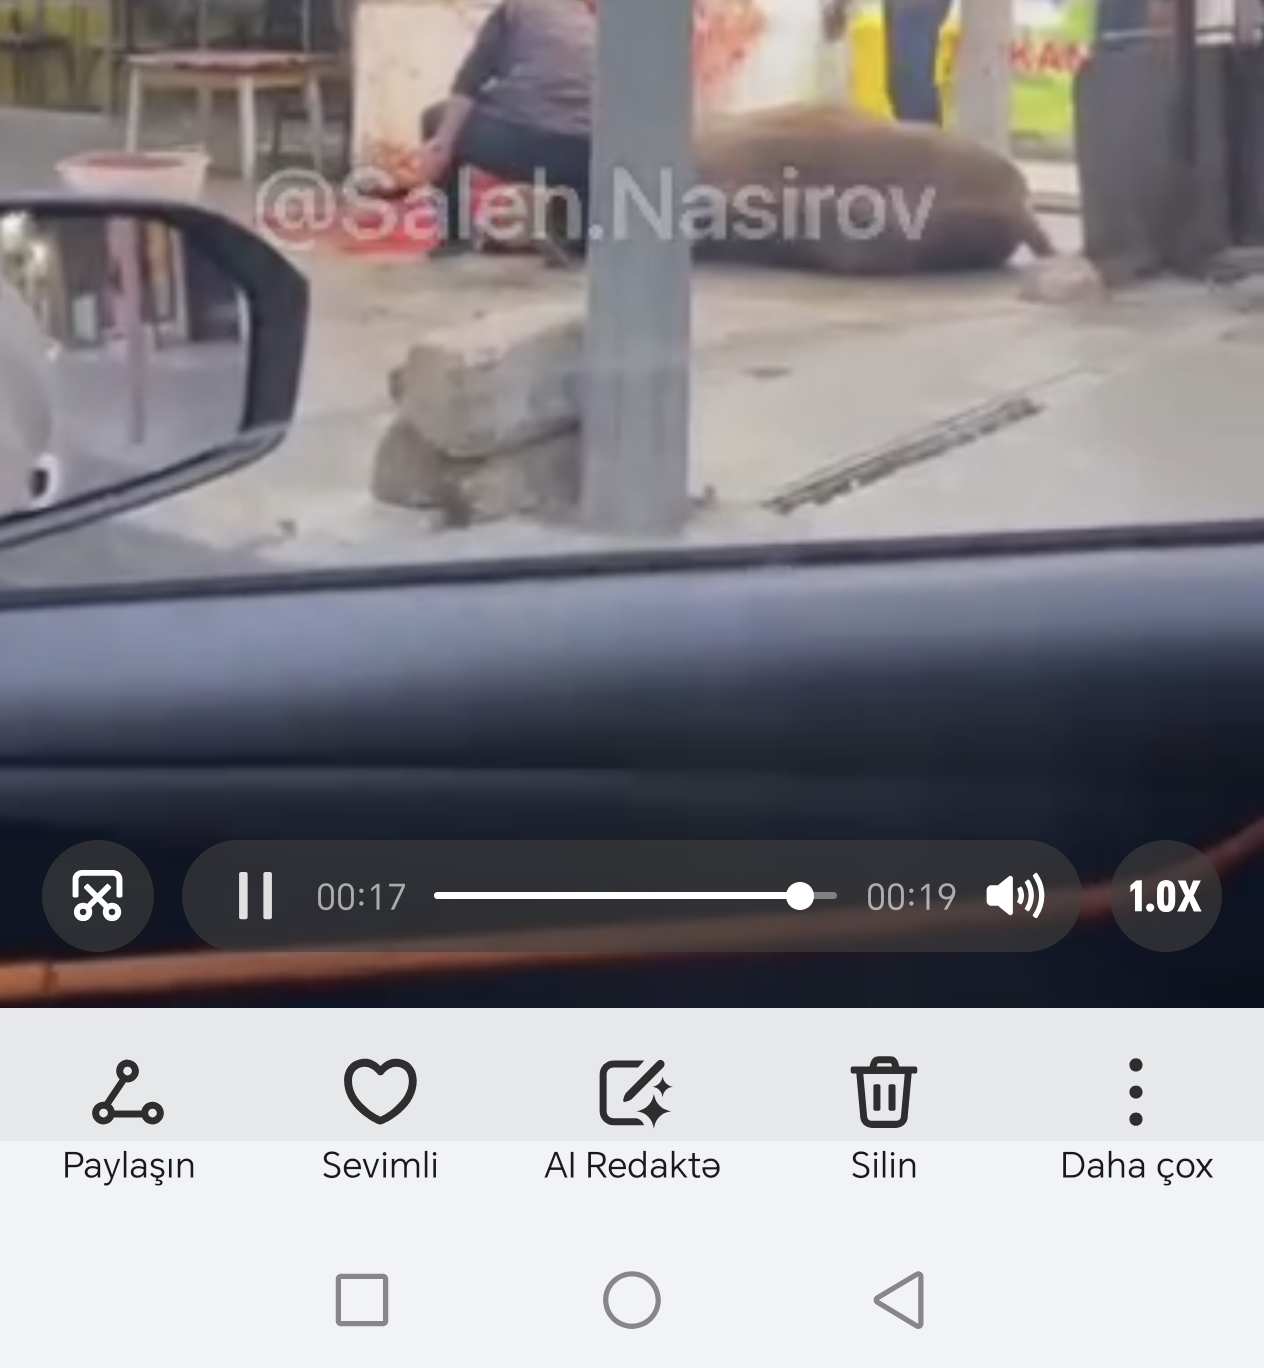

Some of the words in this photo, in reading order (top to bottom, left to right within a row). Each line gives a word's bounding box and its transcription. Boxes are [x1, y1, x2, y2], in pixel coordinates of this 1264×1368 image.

[317, 882, 406, 911] 00:17
[867, 882, 956, 911] 00:19
[1129, 879, 1202, 913] 1.0X
[64, 1150, 194, 1187] Paylaşın
[322, 1150, 438, 1179] Sevimli
[544, 1151, 575, 1179] AI
[587, 1150, 721, 1179] Redaktə
[851, 1150, 916, 1179] Silin
[1062, 1150, 1145, 1179] Daha
[1156, 1157, 1214, 1187] çox
